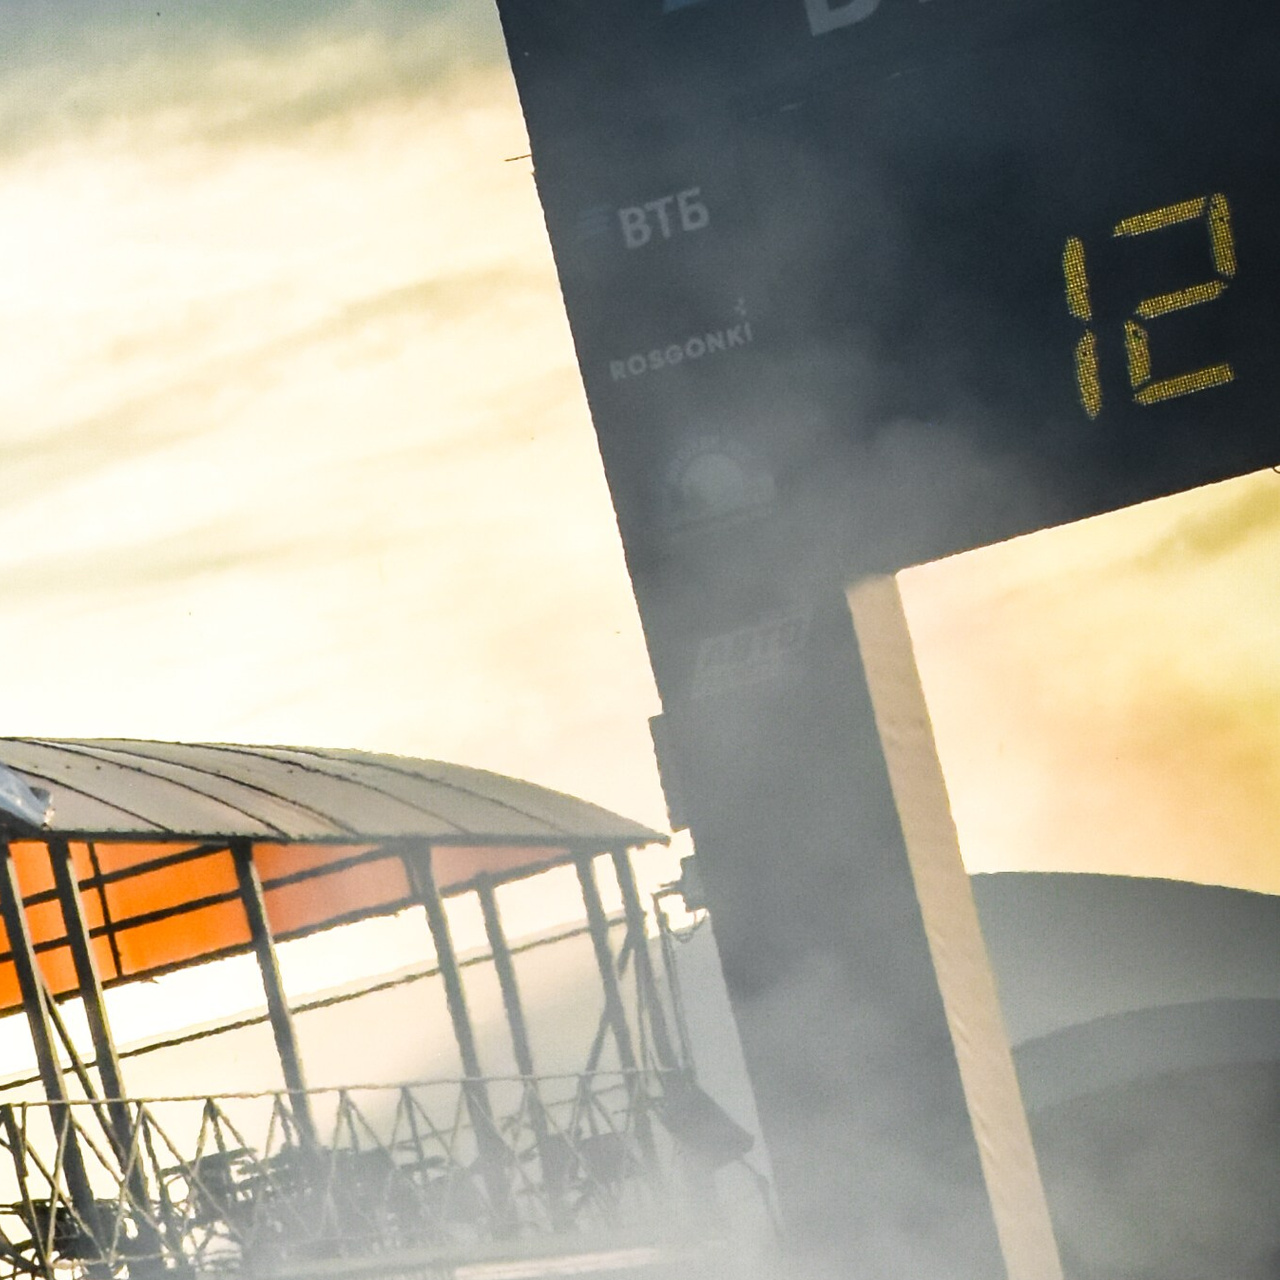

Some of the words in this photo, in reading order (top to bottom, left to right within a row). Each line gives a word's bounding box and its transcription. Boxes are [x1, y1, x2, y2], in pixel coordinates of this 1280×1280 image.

[616, 187, 711, 250] ВТБ
[1061, 191, 1238, 420] 12
[609, 317, 755, 382] ROSGONKI
